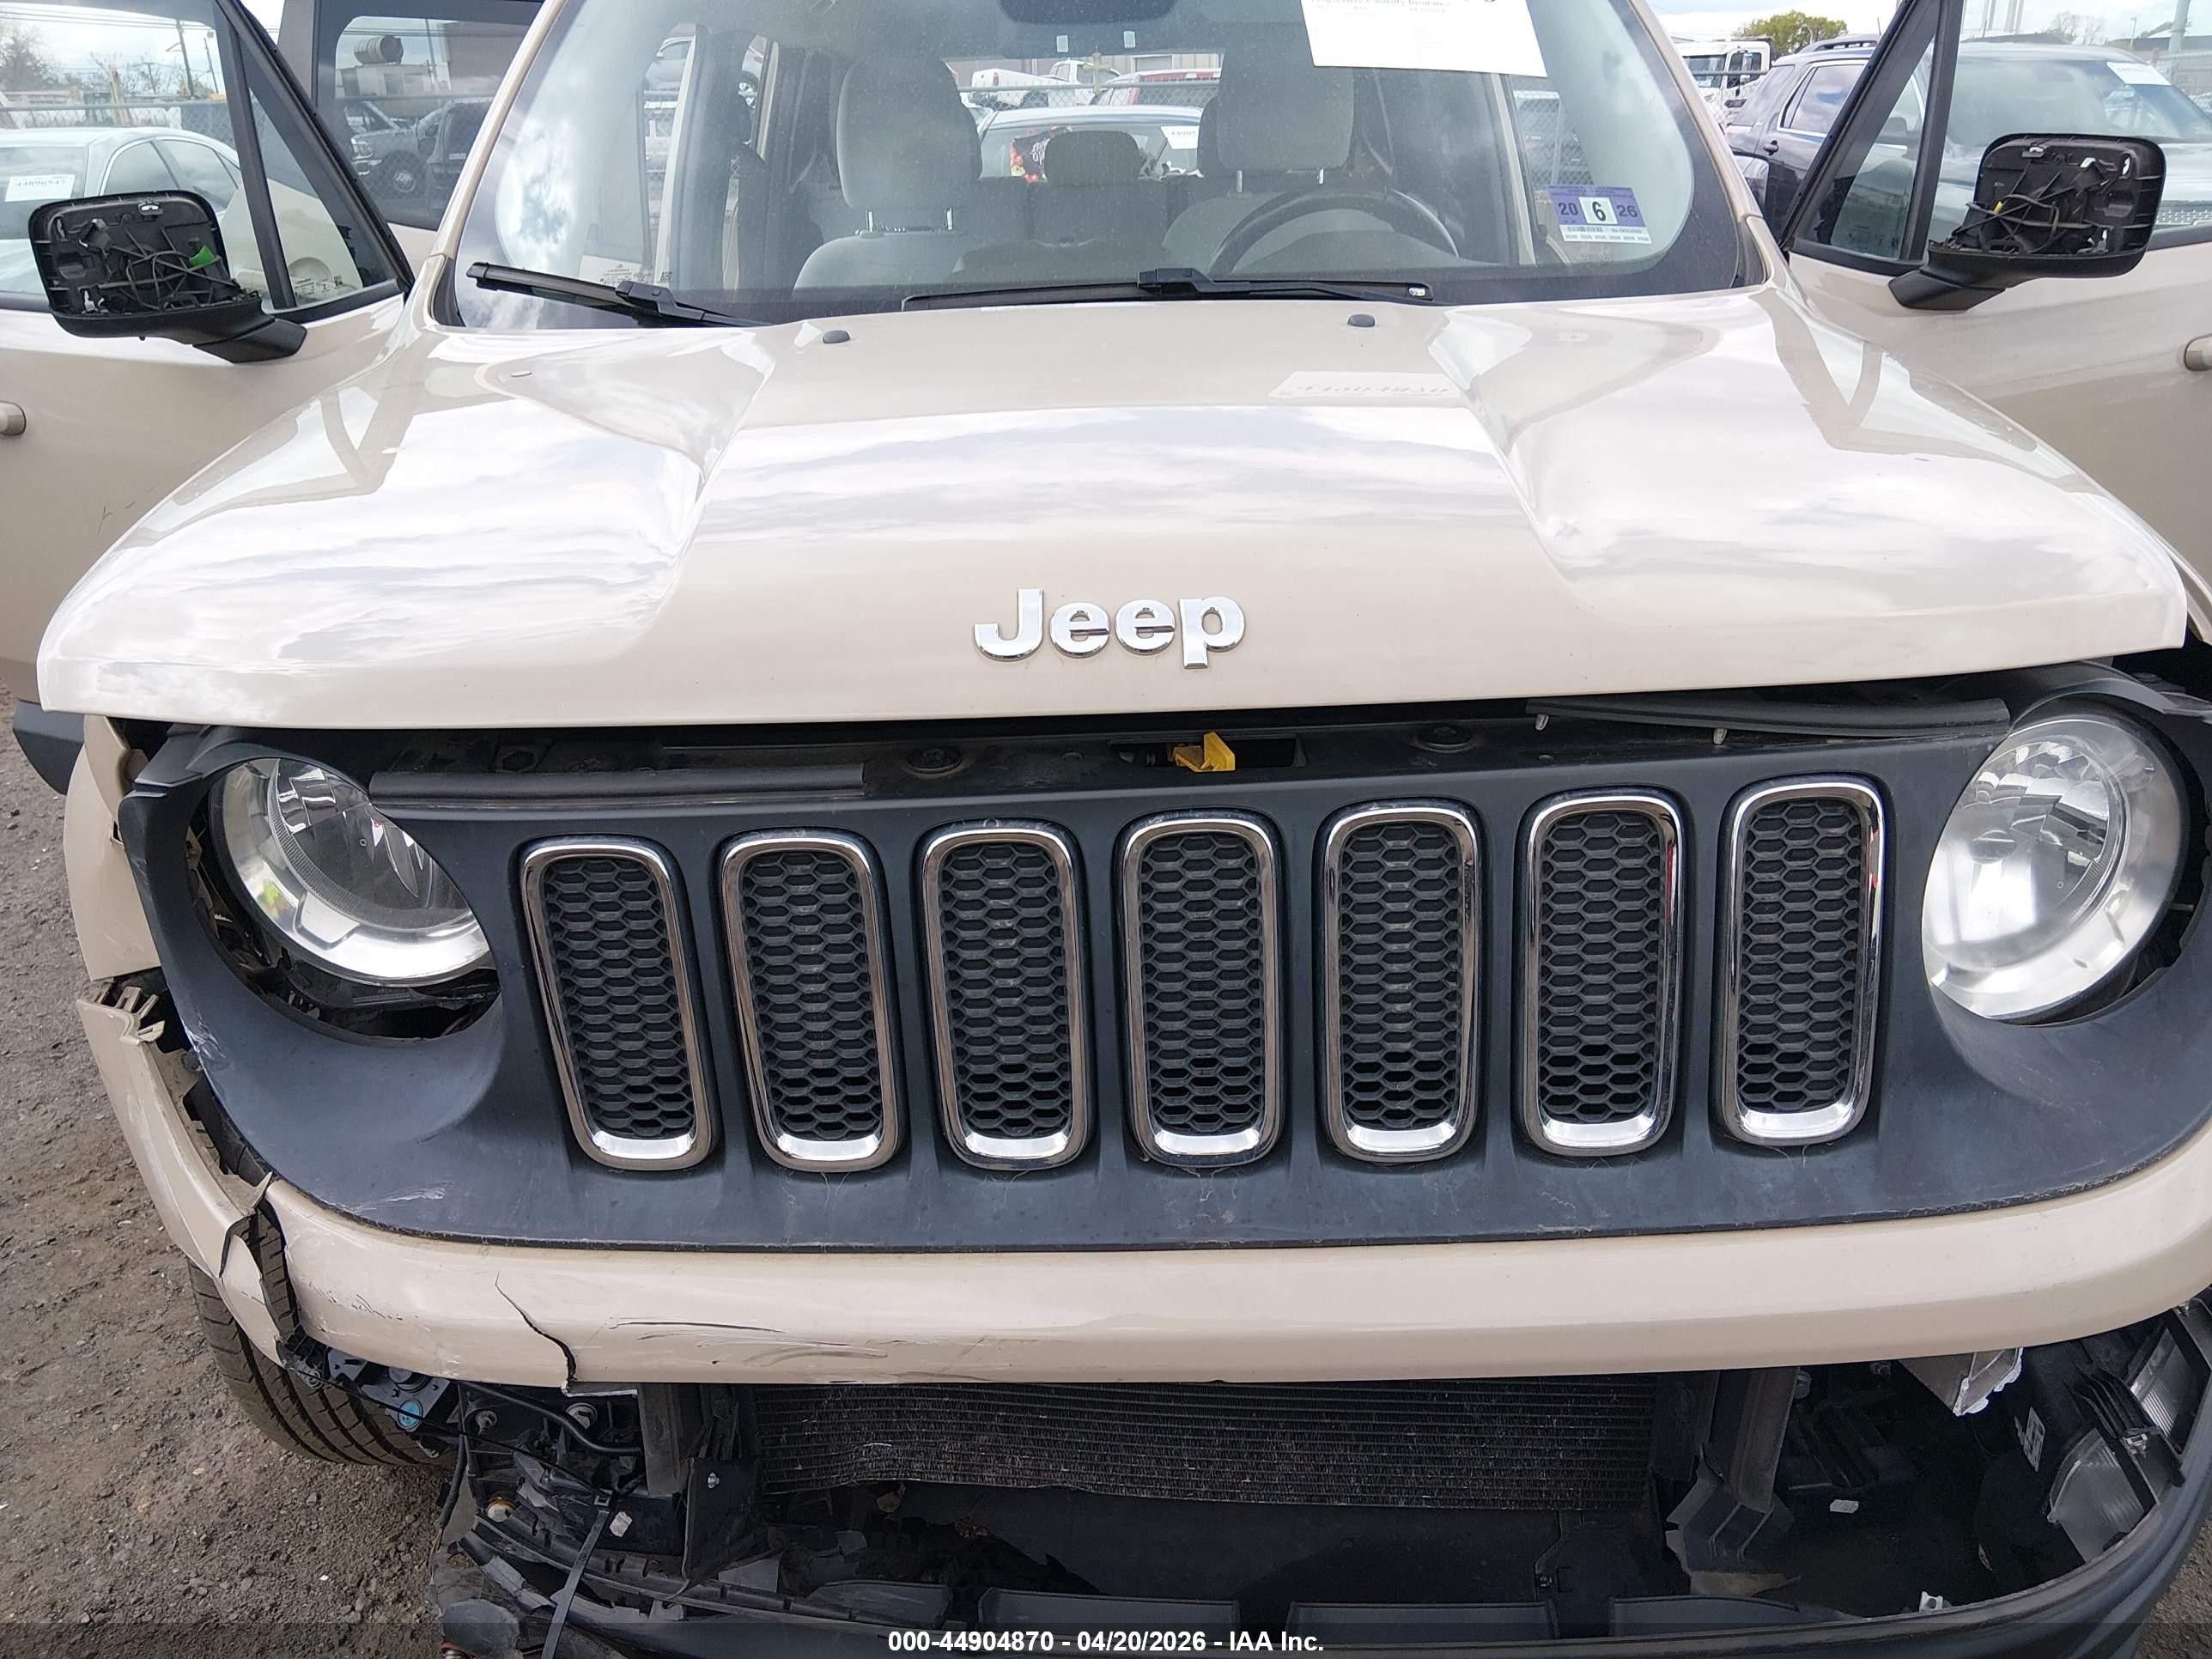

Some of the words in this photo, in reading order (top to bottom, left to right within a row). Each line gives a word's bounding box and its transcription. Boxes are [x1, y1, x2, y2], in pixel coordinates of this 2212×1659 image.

[1558, 202, 1578, 216] 20
[1592, 201, 1607, 222] 6
[1618, 204, 1638, 218] 26
[973, 587, 1245, 670] Jeep
